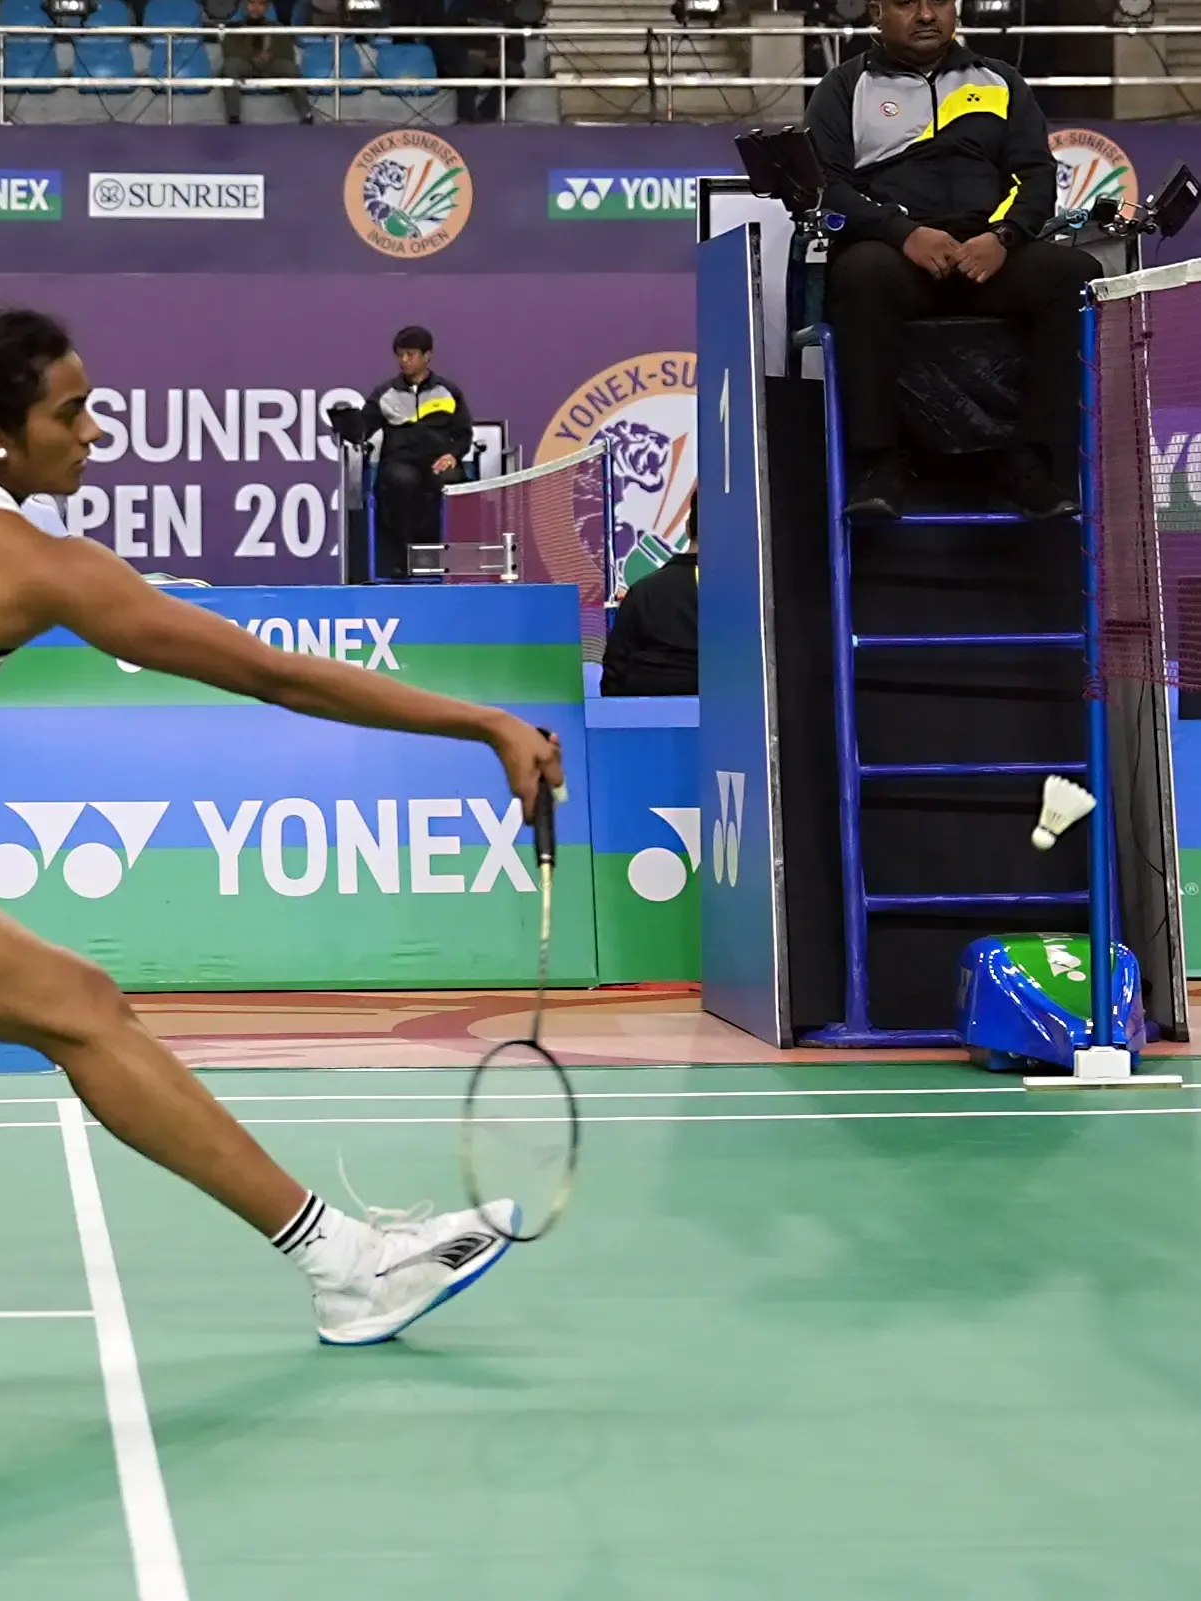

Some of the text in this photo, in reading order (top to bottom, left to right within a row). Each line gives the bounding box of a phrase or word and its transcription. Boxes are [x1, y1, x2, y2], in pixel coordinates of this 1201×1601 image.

[128, 182, 260, 209] SUNRISE
[367, 228, 450, 253] INDIA OPEN
[193, 797, 538, 897] YONEX
